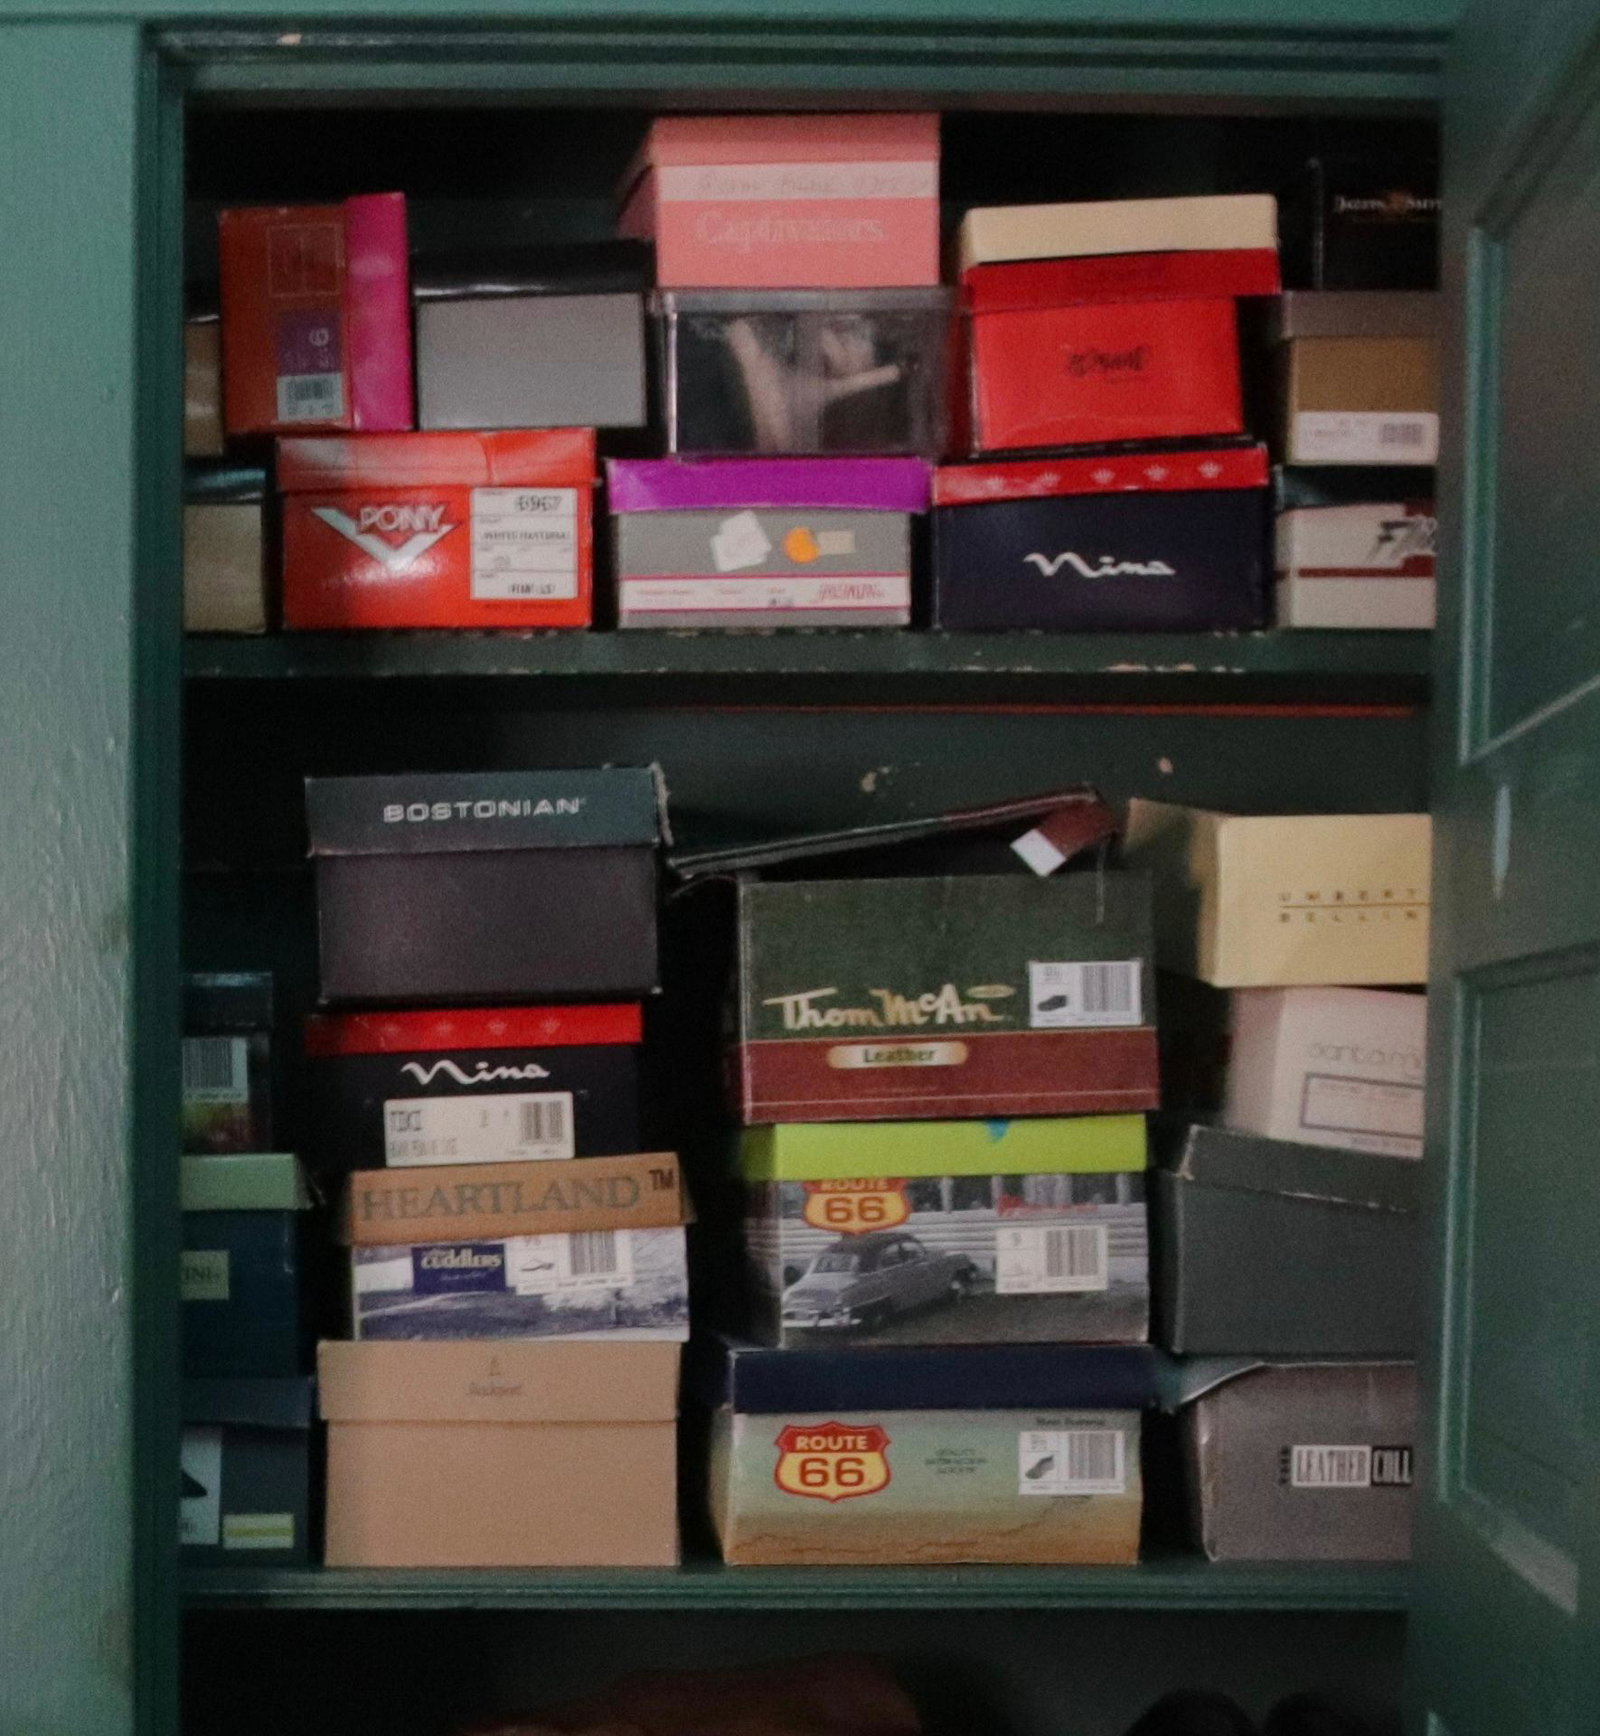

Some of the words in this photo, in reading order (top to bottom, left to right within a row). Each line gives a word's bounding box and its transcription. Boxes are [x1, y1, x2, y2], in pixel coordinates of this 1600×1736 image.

[360, 505, 446, 531] PONY
[382, 797, 580, 823] BOSTONIAN
[762, 986, 884, 1030] Thom
[869, 983, 1003, 1027] McAn
[863, 1046, 938, 1064] Leather
[820, 1178, 890, 1192] ROUTE
[361, 1175, 642, 1222] HEARTLAND
[825, 1196, 886, 1224] 66
[795, 1435, 869, 1451] ROUTE
[799, 1457, 865, 1488] 66
